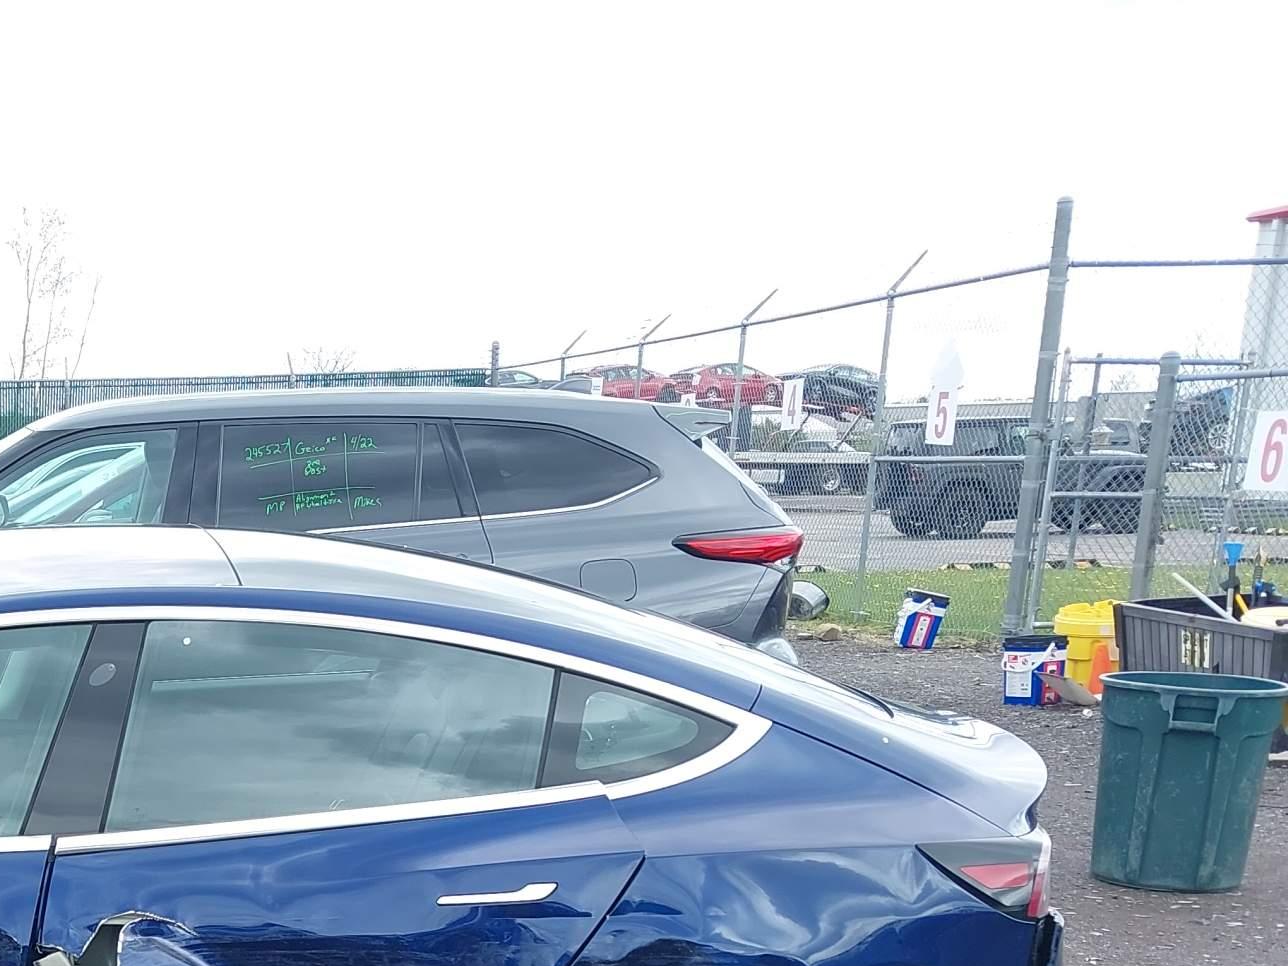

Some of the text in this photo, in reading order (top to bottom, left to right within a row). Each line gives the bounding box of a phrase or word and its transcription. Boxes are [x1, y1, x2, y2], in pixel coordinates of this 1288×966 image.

[787, 384, 797, 425] 4
[934, 391, 950, 439] 5
[350, 433, 378, 450] 4/22
[1260, 418, 1288, 483] 6
